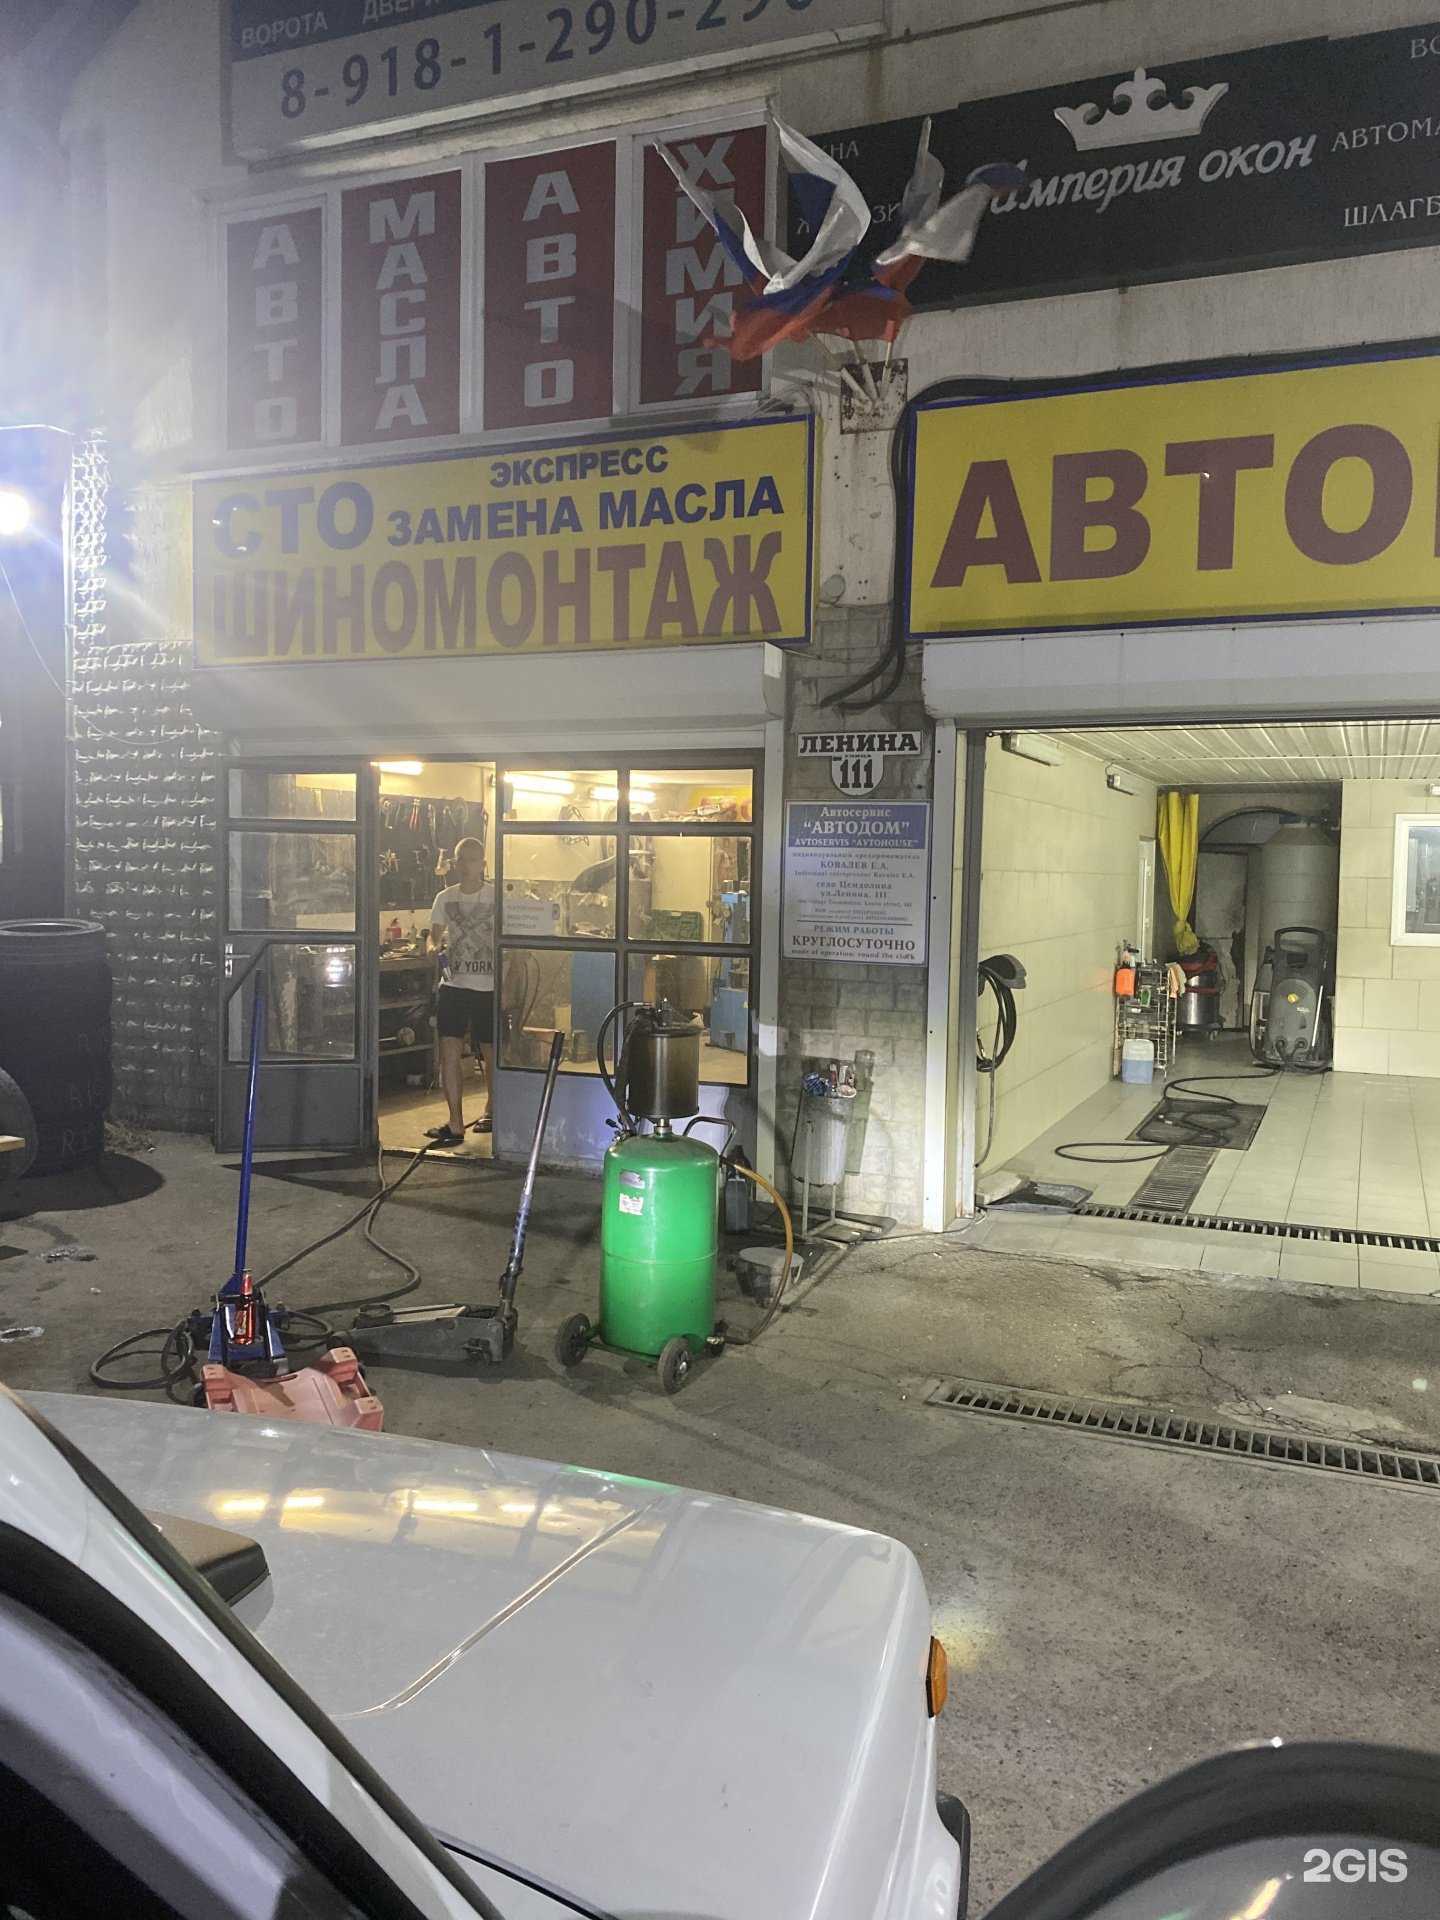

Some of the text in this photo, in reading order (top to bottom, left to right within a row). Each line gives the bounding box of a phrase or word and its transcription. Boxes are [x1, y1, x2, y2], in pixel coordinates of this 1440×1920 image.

[240, 0, 439, 48] ВОРОТА ДВЕ
[281, 0, 814, 118] 8-918-1-290-2
[1343, 195, 1440, 228] ШЛАГБ
[521, 169, 580, 408] АВТО
[251, 223, 300, 442] АВТО
[368, 191, 435, 433] МАСЛА
[490, 445, 669, 488] ЭКСПРЕСС
[212, 475, 784, 559] СТО ЗАМЕНА МАСЛА
[930, 423, 1440, 588] АВТО
[213, 530, 783, 659] ШИНОМОНТАЖ
[799, 733, 919, 753] ЛЕНИНА
[839, 758, 874, 789] 111
[820, 806, 892, 819] Автосервис
[792, 935, 916, 951] КРУГЛОСУТОЧНО
[814, 925, 894, 936] РЕЖИМ РАБОТЫ
[464, 960, 493, 974] YORK
